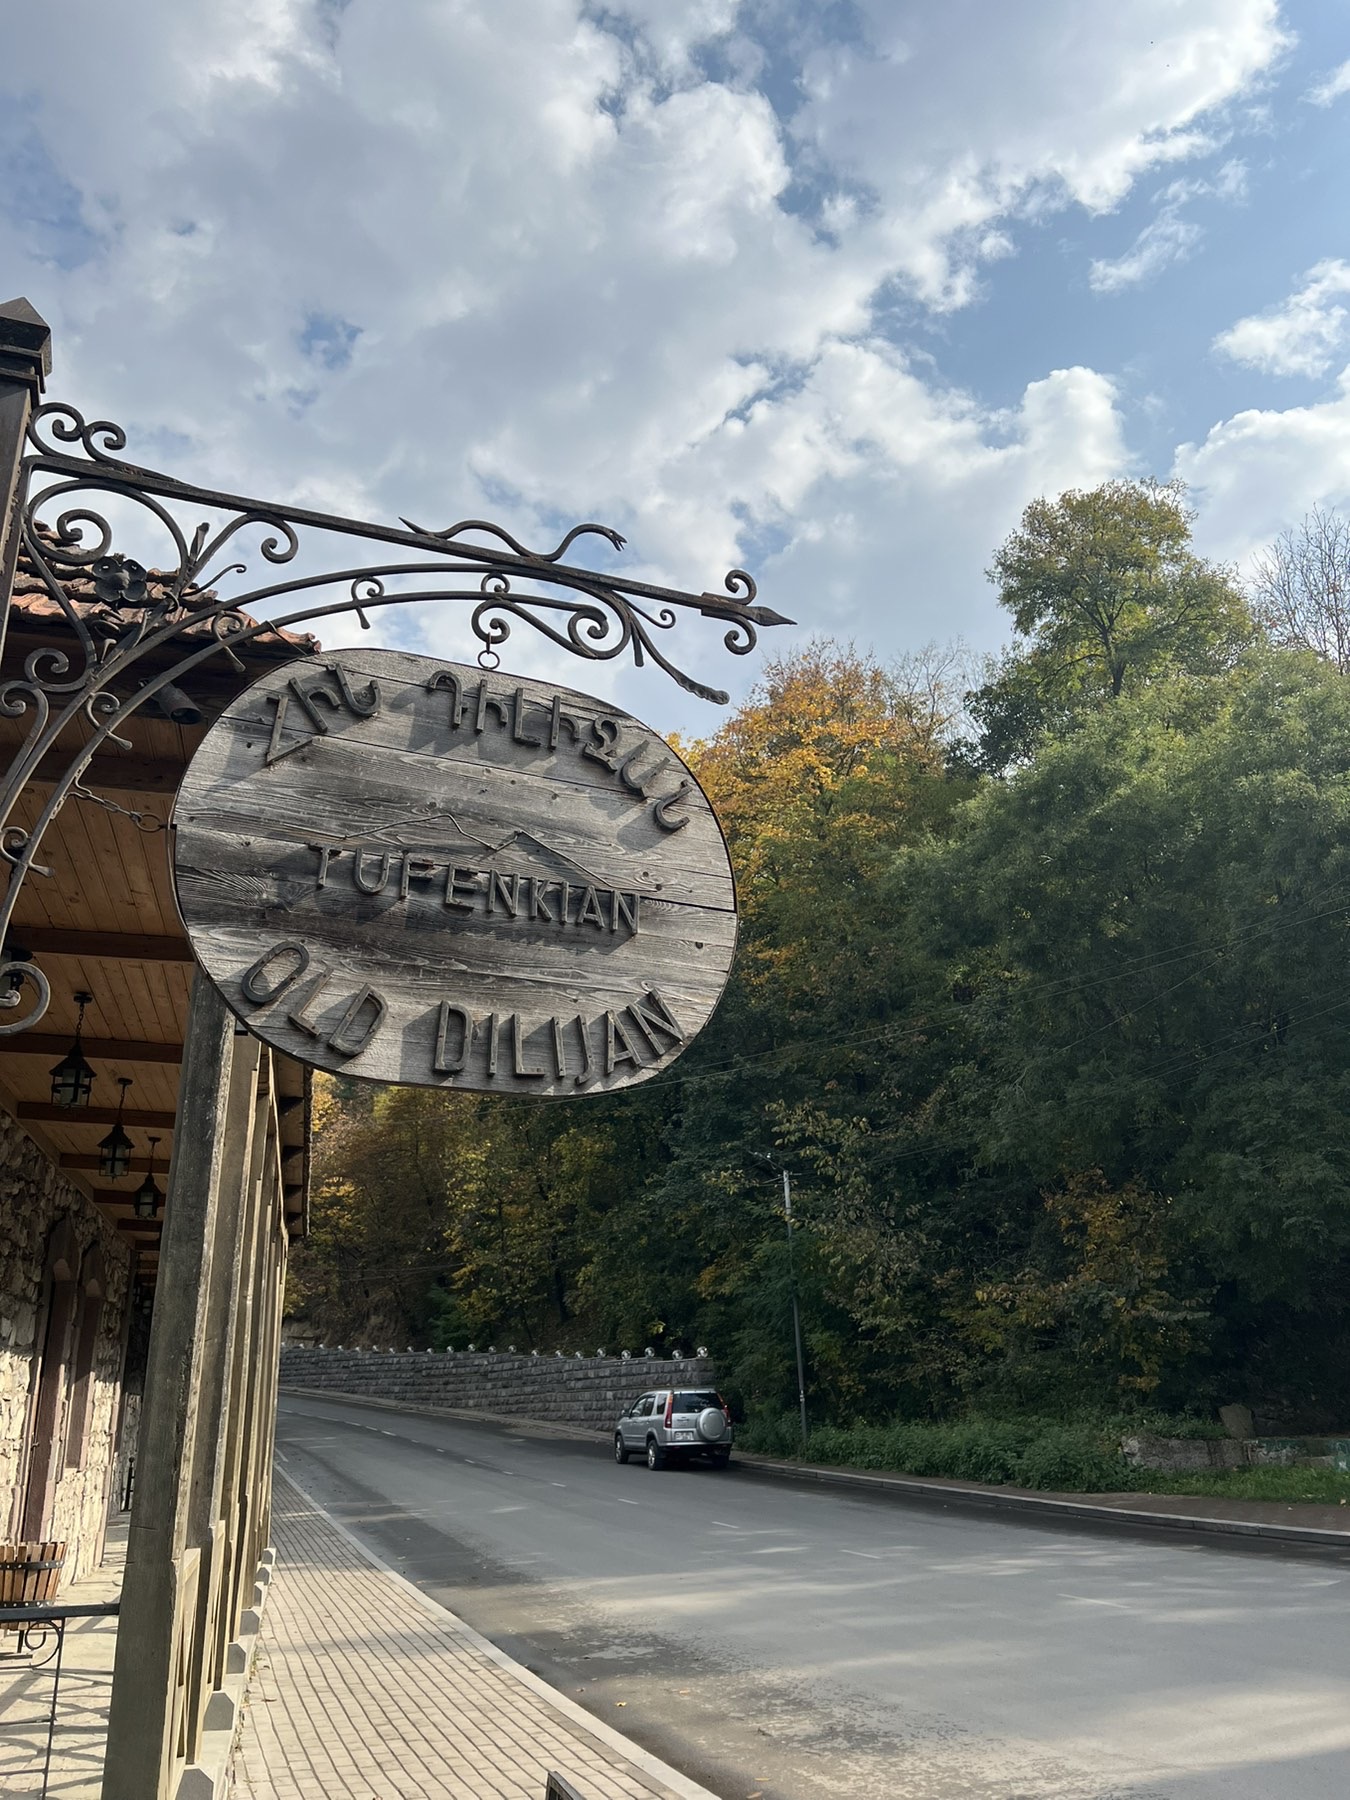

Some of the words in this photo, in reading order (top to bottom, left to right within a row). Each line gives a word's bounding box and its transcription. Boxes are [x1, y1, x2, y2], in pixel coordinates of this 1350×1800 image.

[266, 663, 382, 766] ՀԻՆ
[427, 671, 693, 830] ԴԻԼԻՋԱՆ
[308, 843, 641, 935] TUFENKIAN
[242, 941, 389, 1057] OLD
[434, 988, 684, 1085] DILIJAN
